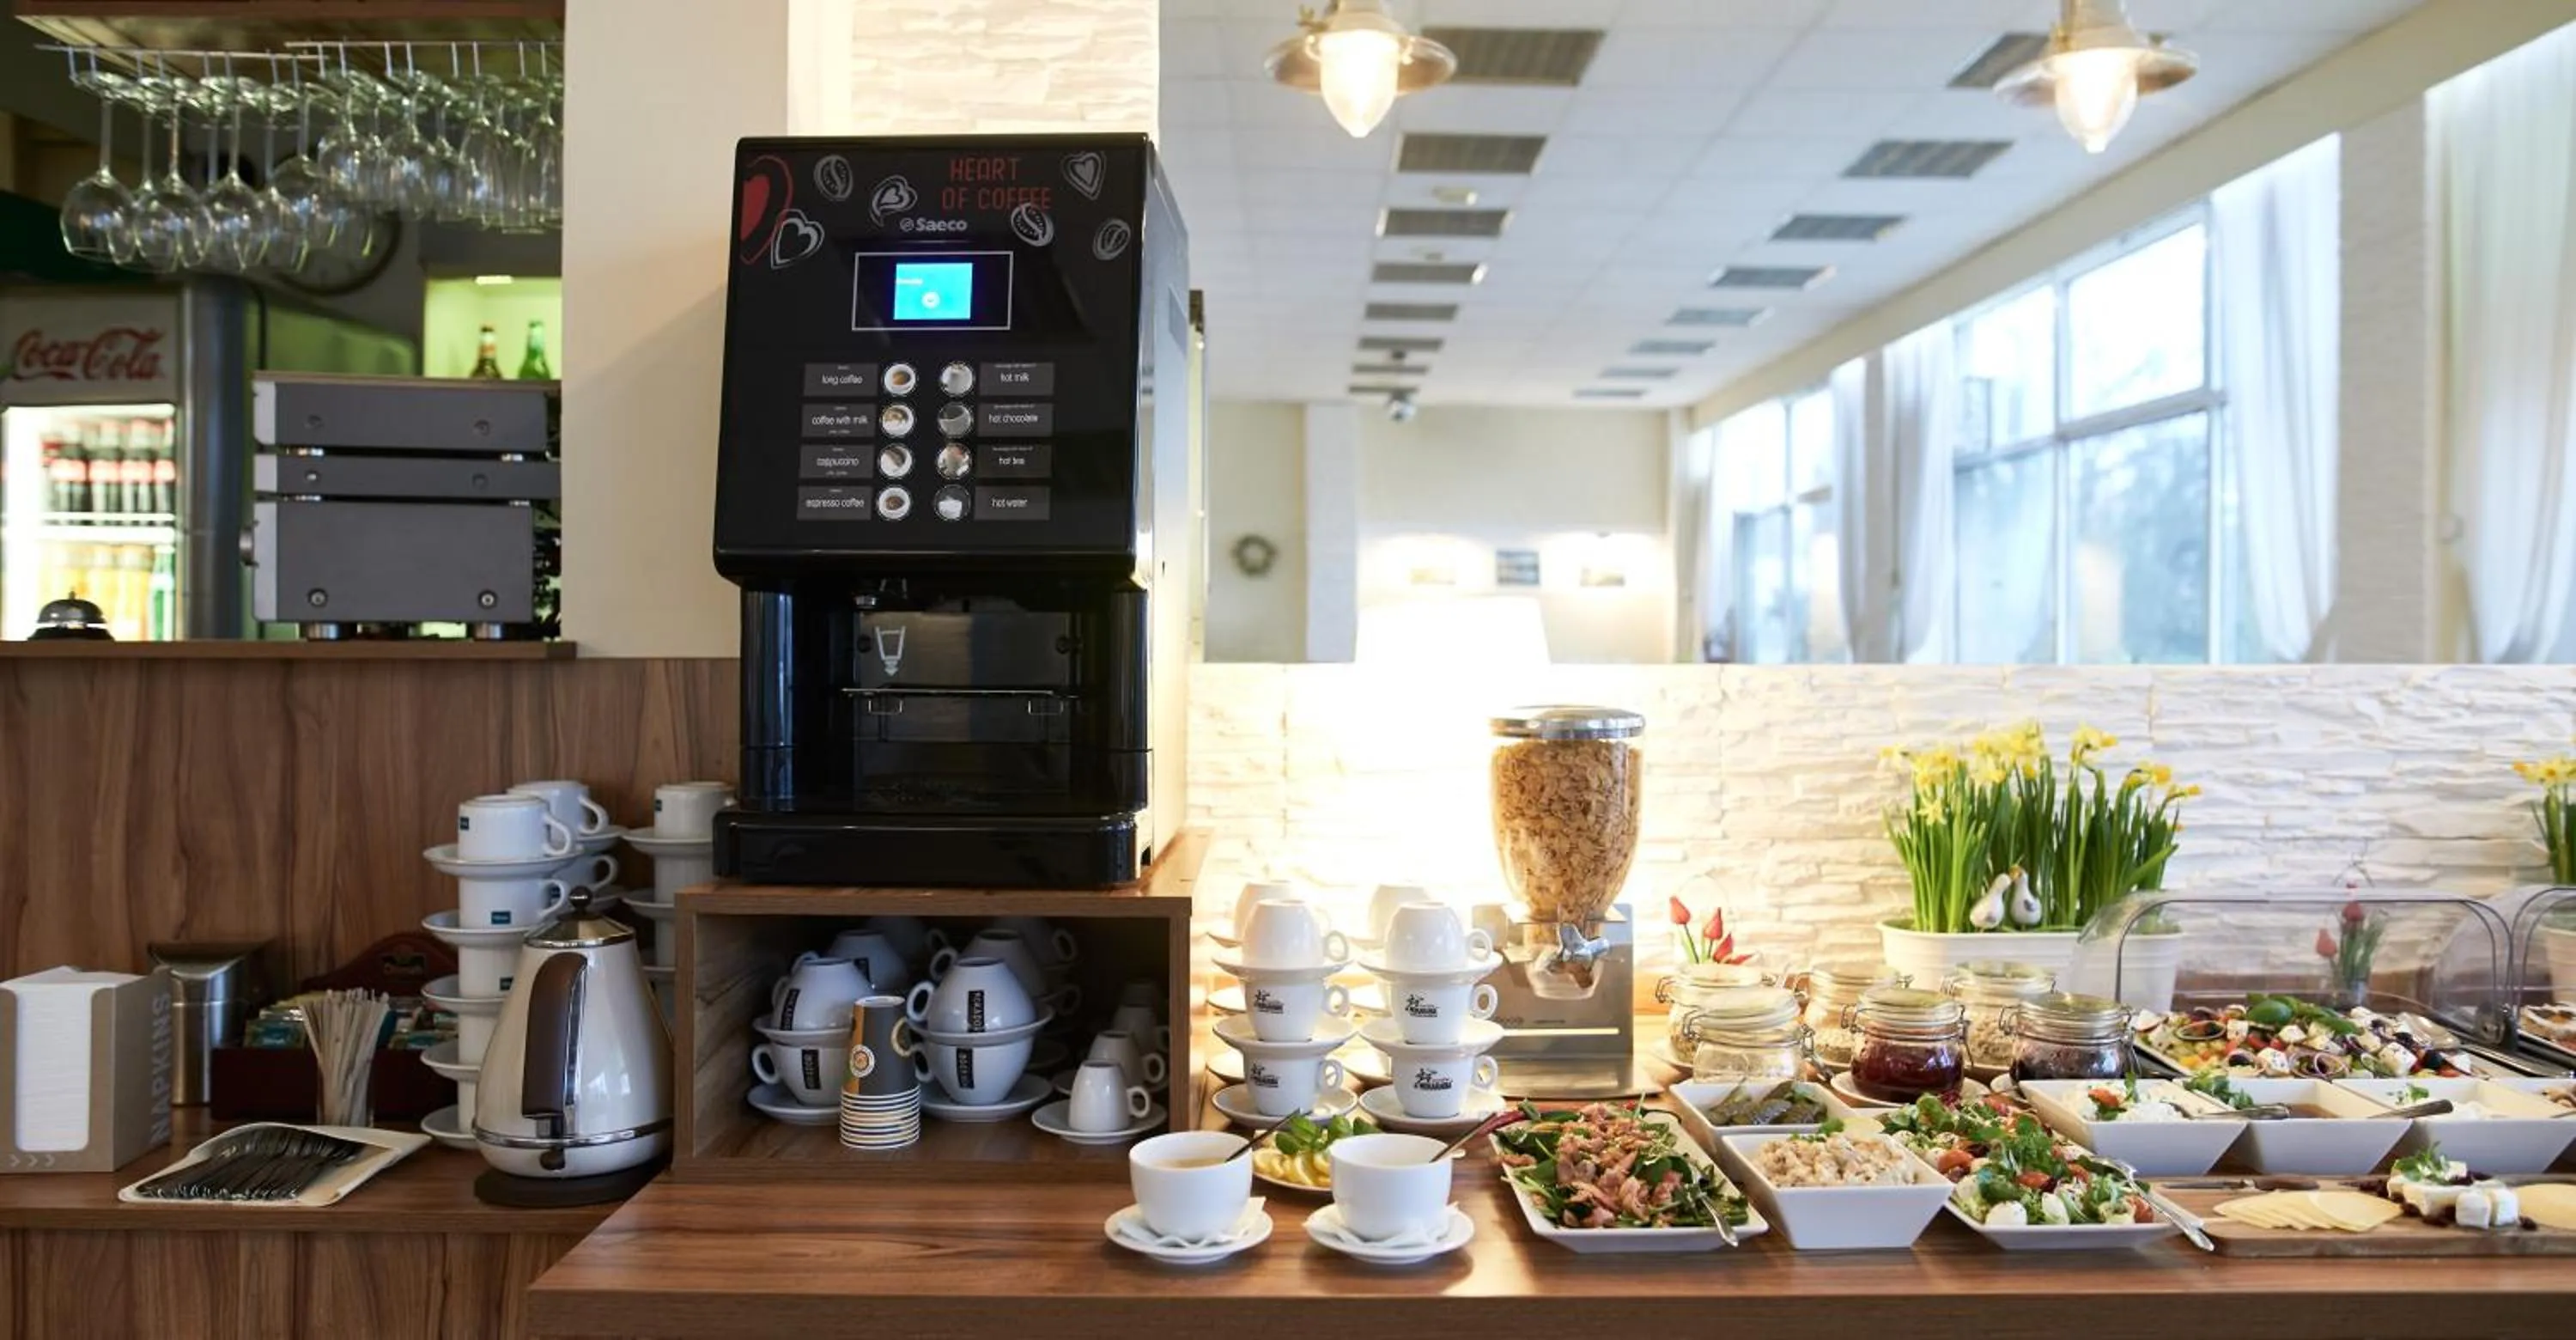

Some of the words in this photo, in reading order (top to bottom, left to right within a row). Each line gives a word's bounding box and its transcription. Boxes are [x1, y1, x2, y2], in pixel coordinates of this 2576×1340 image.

[950, 157, 1022, 181] HEART
[941, 187, 969, 210] OF
[978, 186, 1052, 210] COFFEE
[915, 218, 968, 232] Saeco
[840, 374, 864, 385] coffee
[1000, 372, 1013, 382] hot
[1014, 372, 1030, 382] milk
[811, 415, 835, 425] coffee
[988, 413, 1002, 423] hot
[841, 497, 865, 508] coffee
[149, 992, 171, 1145] NAPKINS
